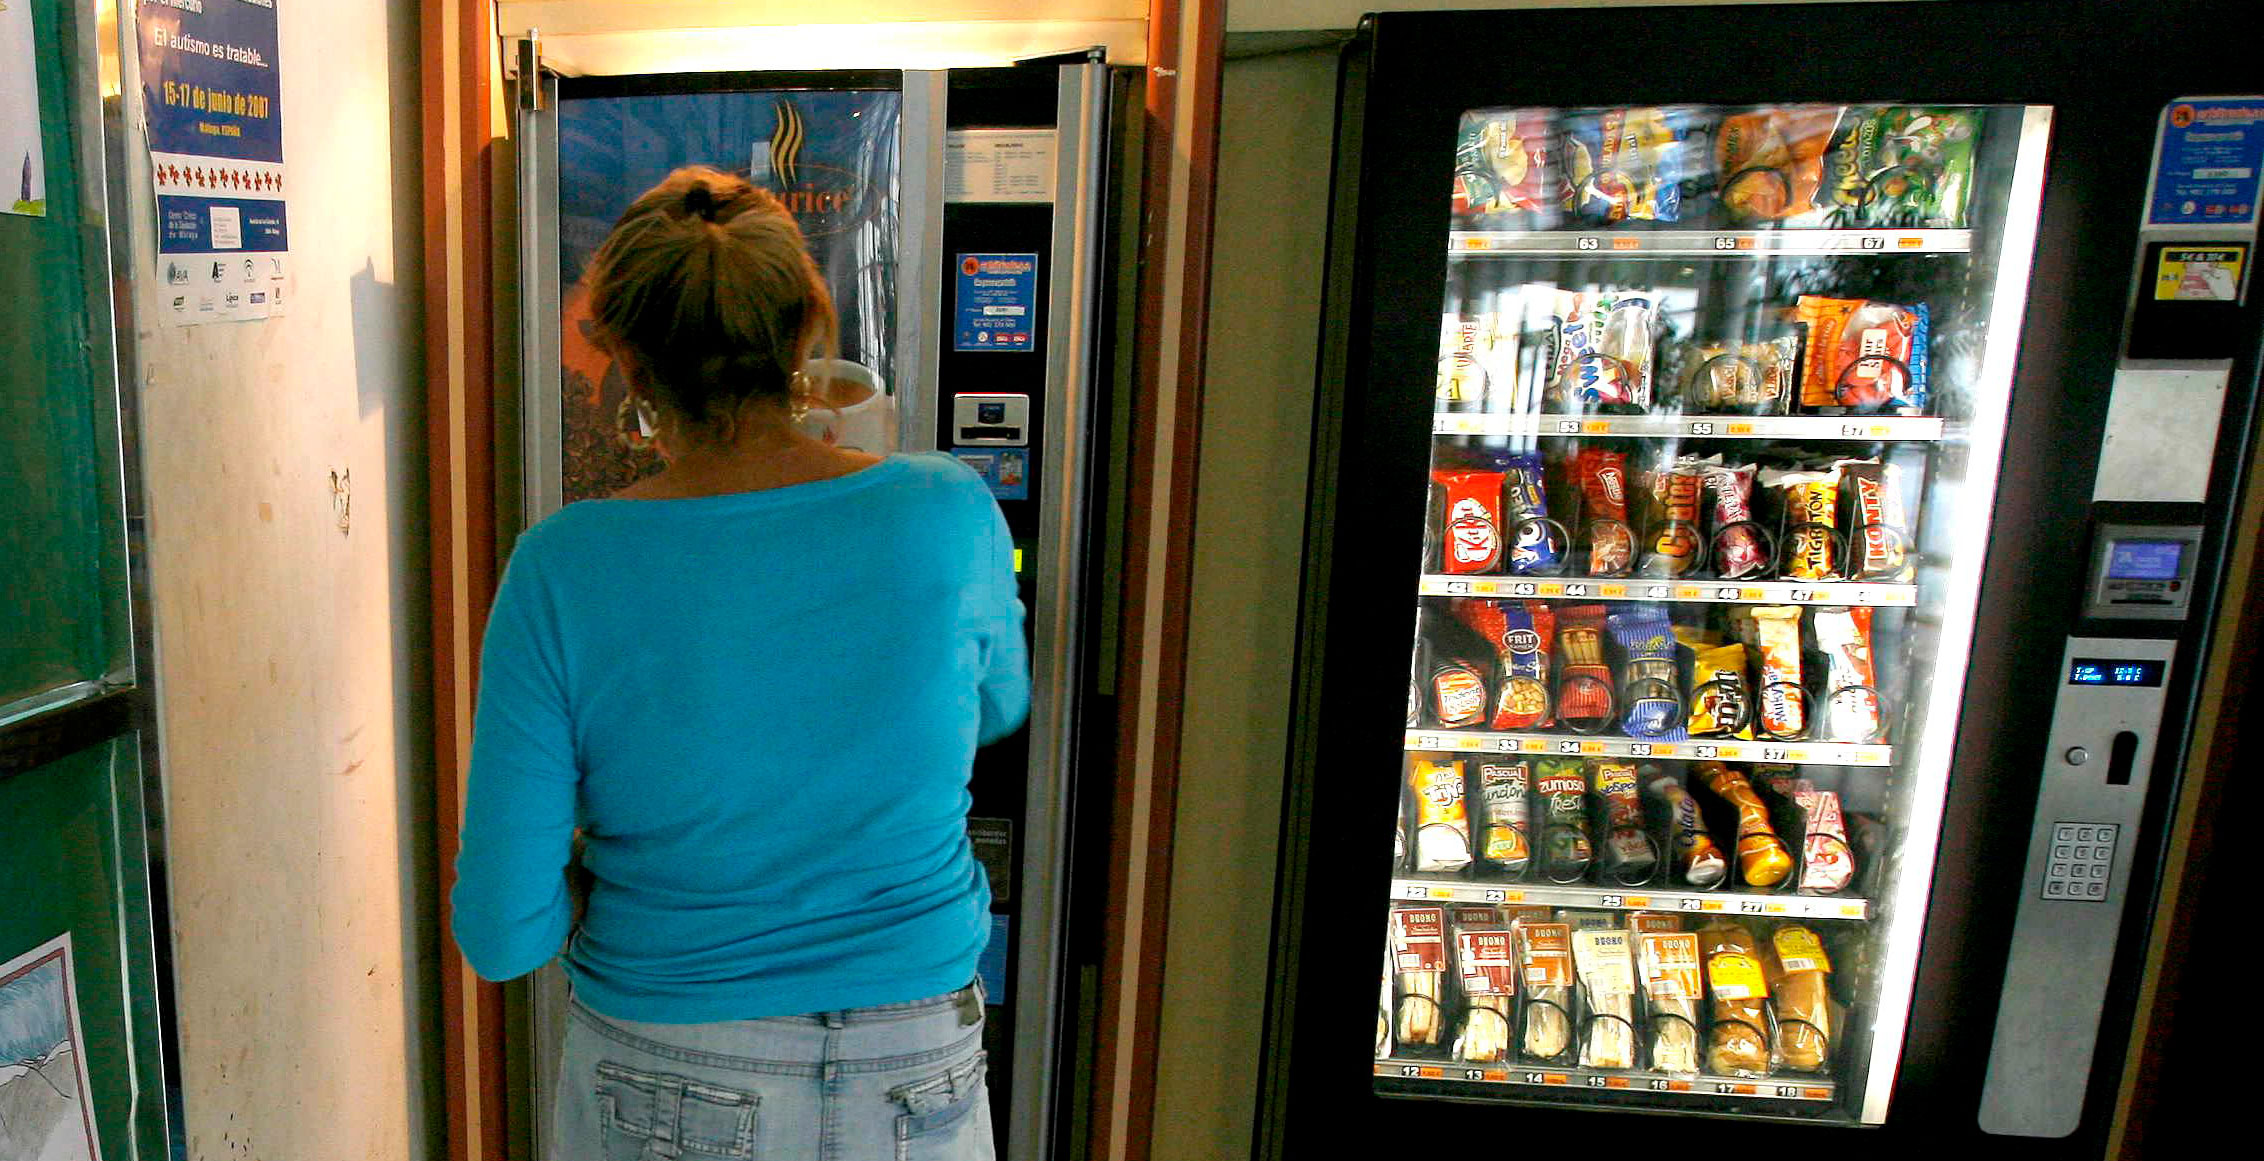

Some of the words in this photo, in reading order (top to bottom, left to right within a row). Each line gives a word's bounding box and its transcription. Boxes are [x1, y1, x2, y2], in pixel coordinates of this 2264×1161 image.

[154, 27, 167, 46] El
[170, 33, 210, 56] autismo
[212, 43, 224, 59] es
[163, 79, 190, 108] 15-17
[192, 85, 206, 110] de
[207, 87, 232, 113] junio
[234, 93, 246, 116] de
[1579, 238, 1598, 250] 63
[1716, 238, 1735, 249] 65
[1864, 238, 1884, 249] 67
[1563, 323, 1599, 401] Sweet
[1692, 423, 1712, 435] 55
[1860, 478, 1887, 558] KONTY
[1807, 490, 1823, 569] TIGRTÓN
[1566, 584, 1586, 596] 44
[1508, 634, 1534, 644] FRIT
[1768, 671, 1787, 722] Milkyar
[1499, 739, 1518, 751] 33
[1561, 741, 1580, 752] 34
[1632, 743, 1651, 755] 35
[1485, 766, 1526, 781] PASCUAL
[1487, 890, 1505, 901] 23
[1603, 895, 1622, 906] 25
[1403, 1066, 1419, 1077] 12
[1466, 1070, 1483, 1081] 13
[1526, 1073, 1543, 1084] 14
[1589, 1076, 1606, 1087] 15
[1651, 1080, 1668, 1091] 16
[1718, 1083, 1735, 1094] 17
[1778, 1087, 1797, 1097] 18
